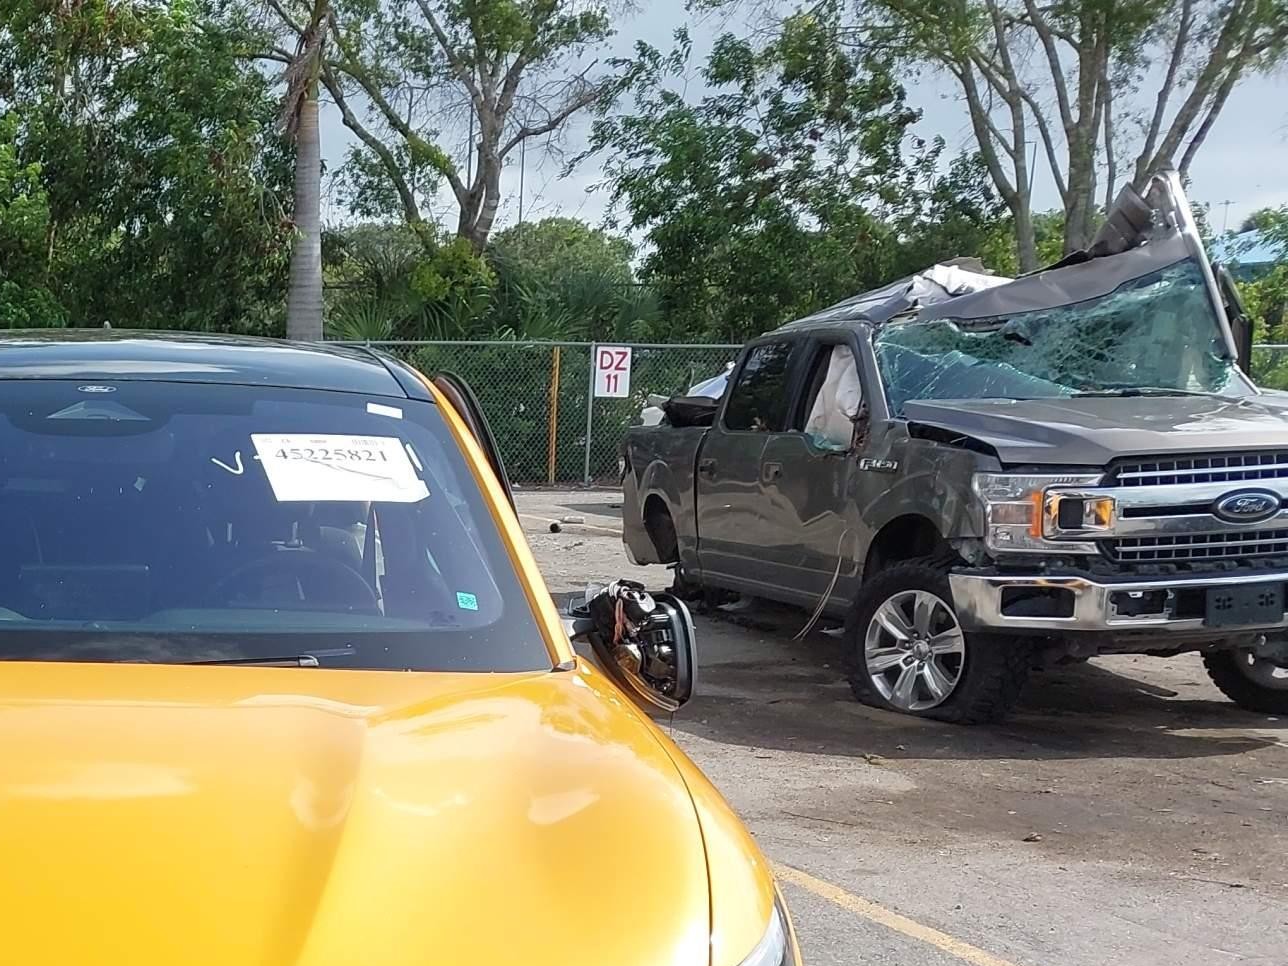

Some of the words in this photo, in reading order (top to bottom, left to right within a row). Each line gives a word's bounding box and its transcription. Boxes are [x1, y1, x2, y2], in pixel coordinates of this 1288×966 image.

[599, 350, 628, 371] DZ
[605, 373, 619, 393] 11
[275, 448, 388, 462] 45225821
[1233, 498, 1267, 513] Ford
